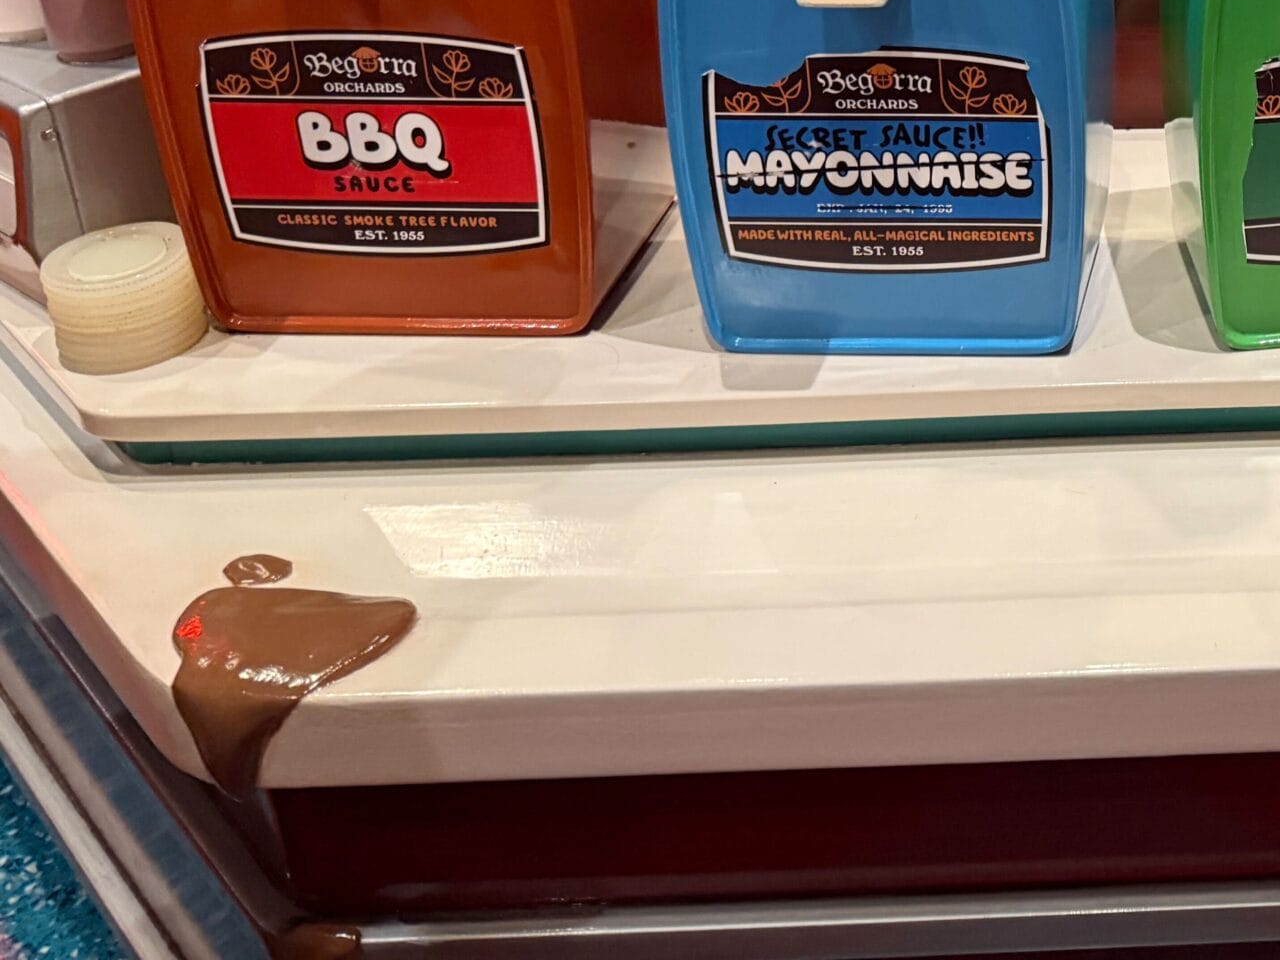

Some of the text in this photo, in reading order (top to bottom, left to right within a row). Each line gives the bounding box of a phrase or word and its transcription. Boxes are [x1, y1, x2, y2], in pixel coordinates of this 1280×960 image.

[324, 82, 405, 94] ORCHARDS
[835, 99, 919, 111] ORCHARDS
[297, 110, 451, 176] BBQ
[764, 122, 986, 150] SECRET SAUCE!!
[726, 149, 1034, 194] MAYONNAISE
[334, 176, 416, 193] SAUCE
[277, 214, 498, 228] CLASSIC SMOKE TREE FLAVOR
[354, 230, 425, 241] EST. 1955
[738, 229, 1035, 243] MADE WITH REAL, ALL-MAGICAL INGREDIENTS
[852, 246, 924, 257] EST. 1955
